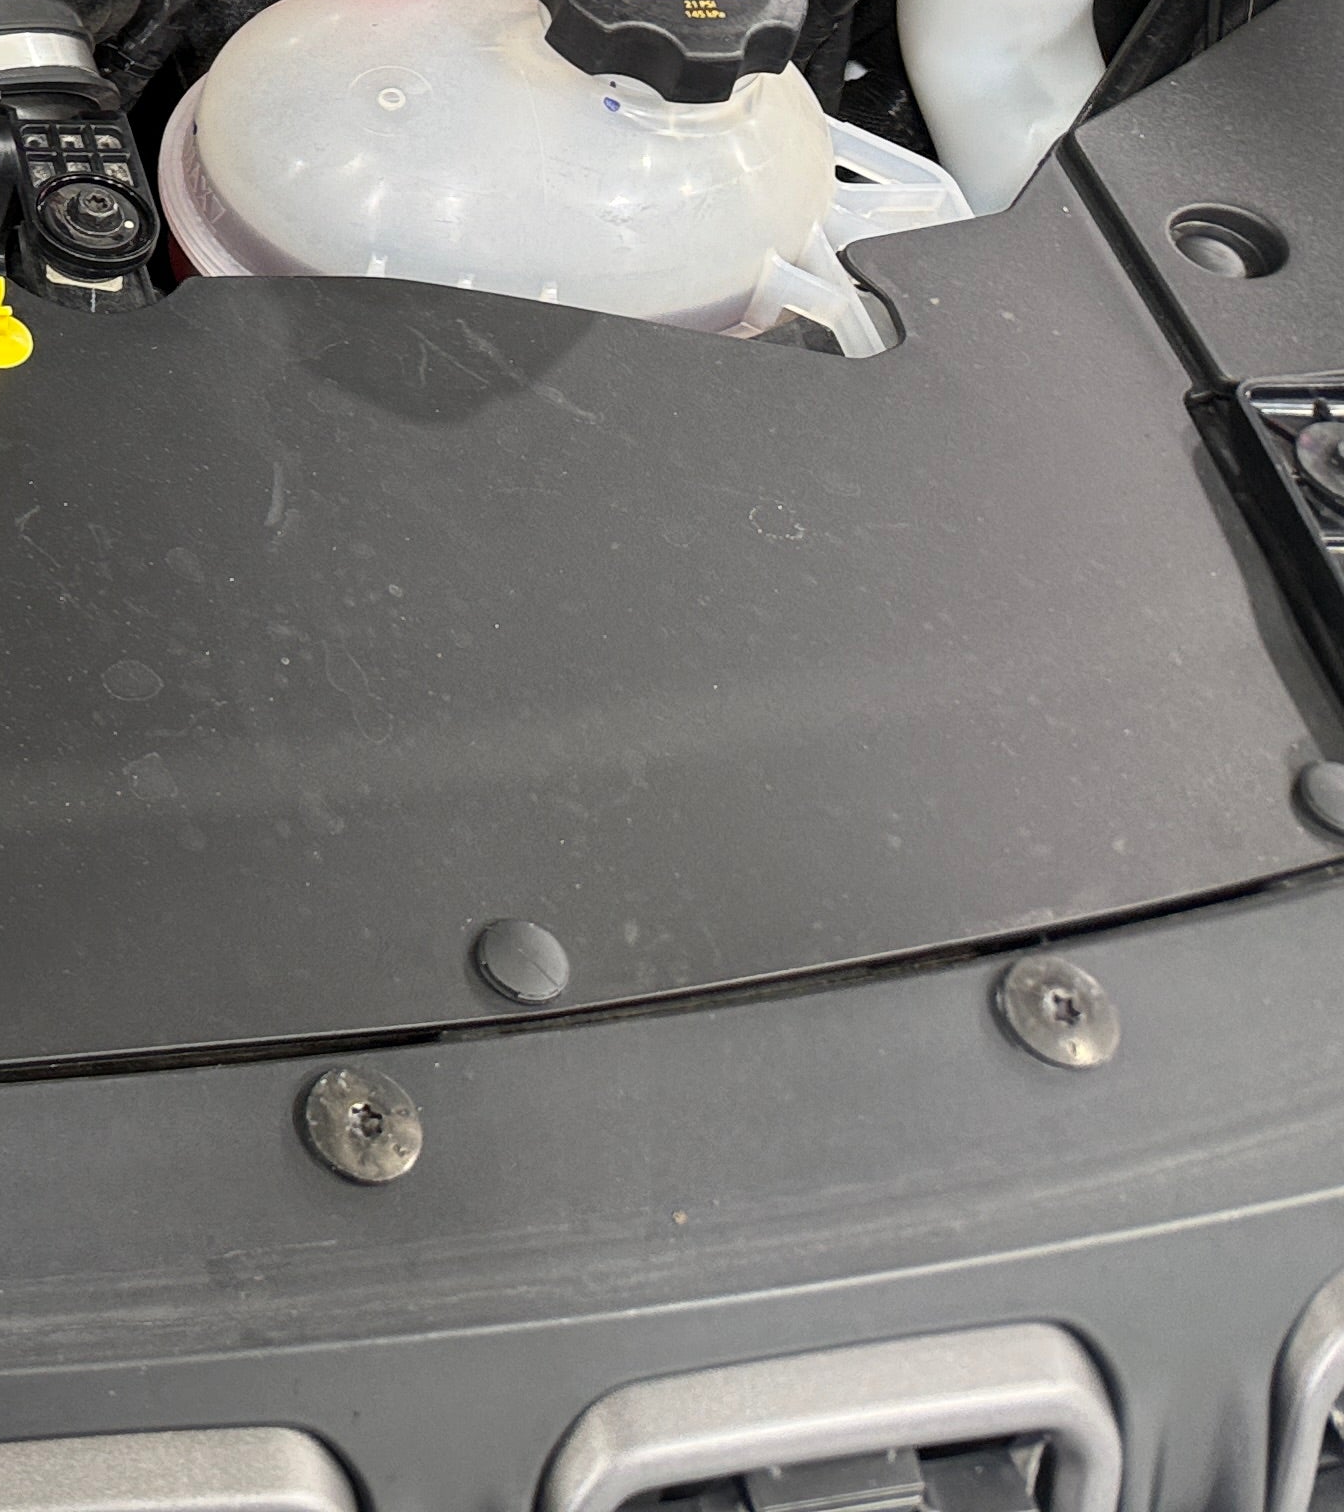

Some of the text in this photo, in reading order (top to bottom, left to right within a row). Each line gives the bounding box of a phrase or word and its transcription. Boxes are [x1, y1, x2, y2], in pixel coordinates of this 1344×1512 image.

[683, 0, 717, 9] 21 PSI
[685, 10, 706, 18] 145
